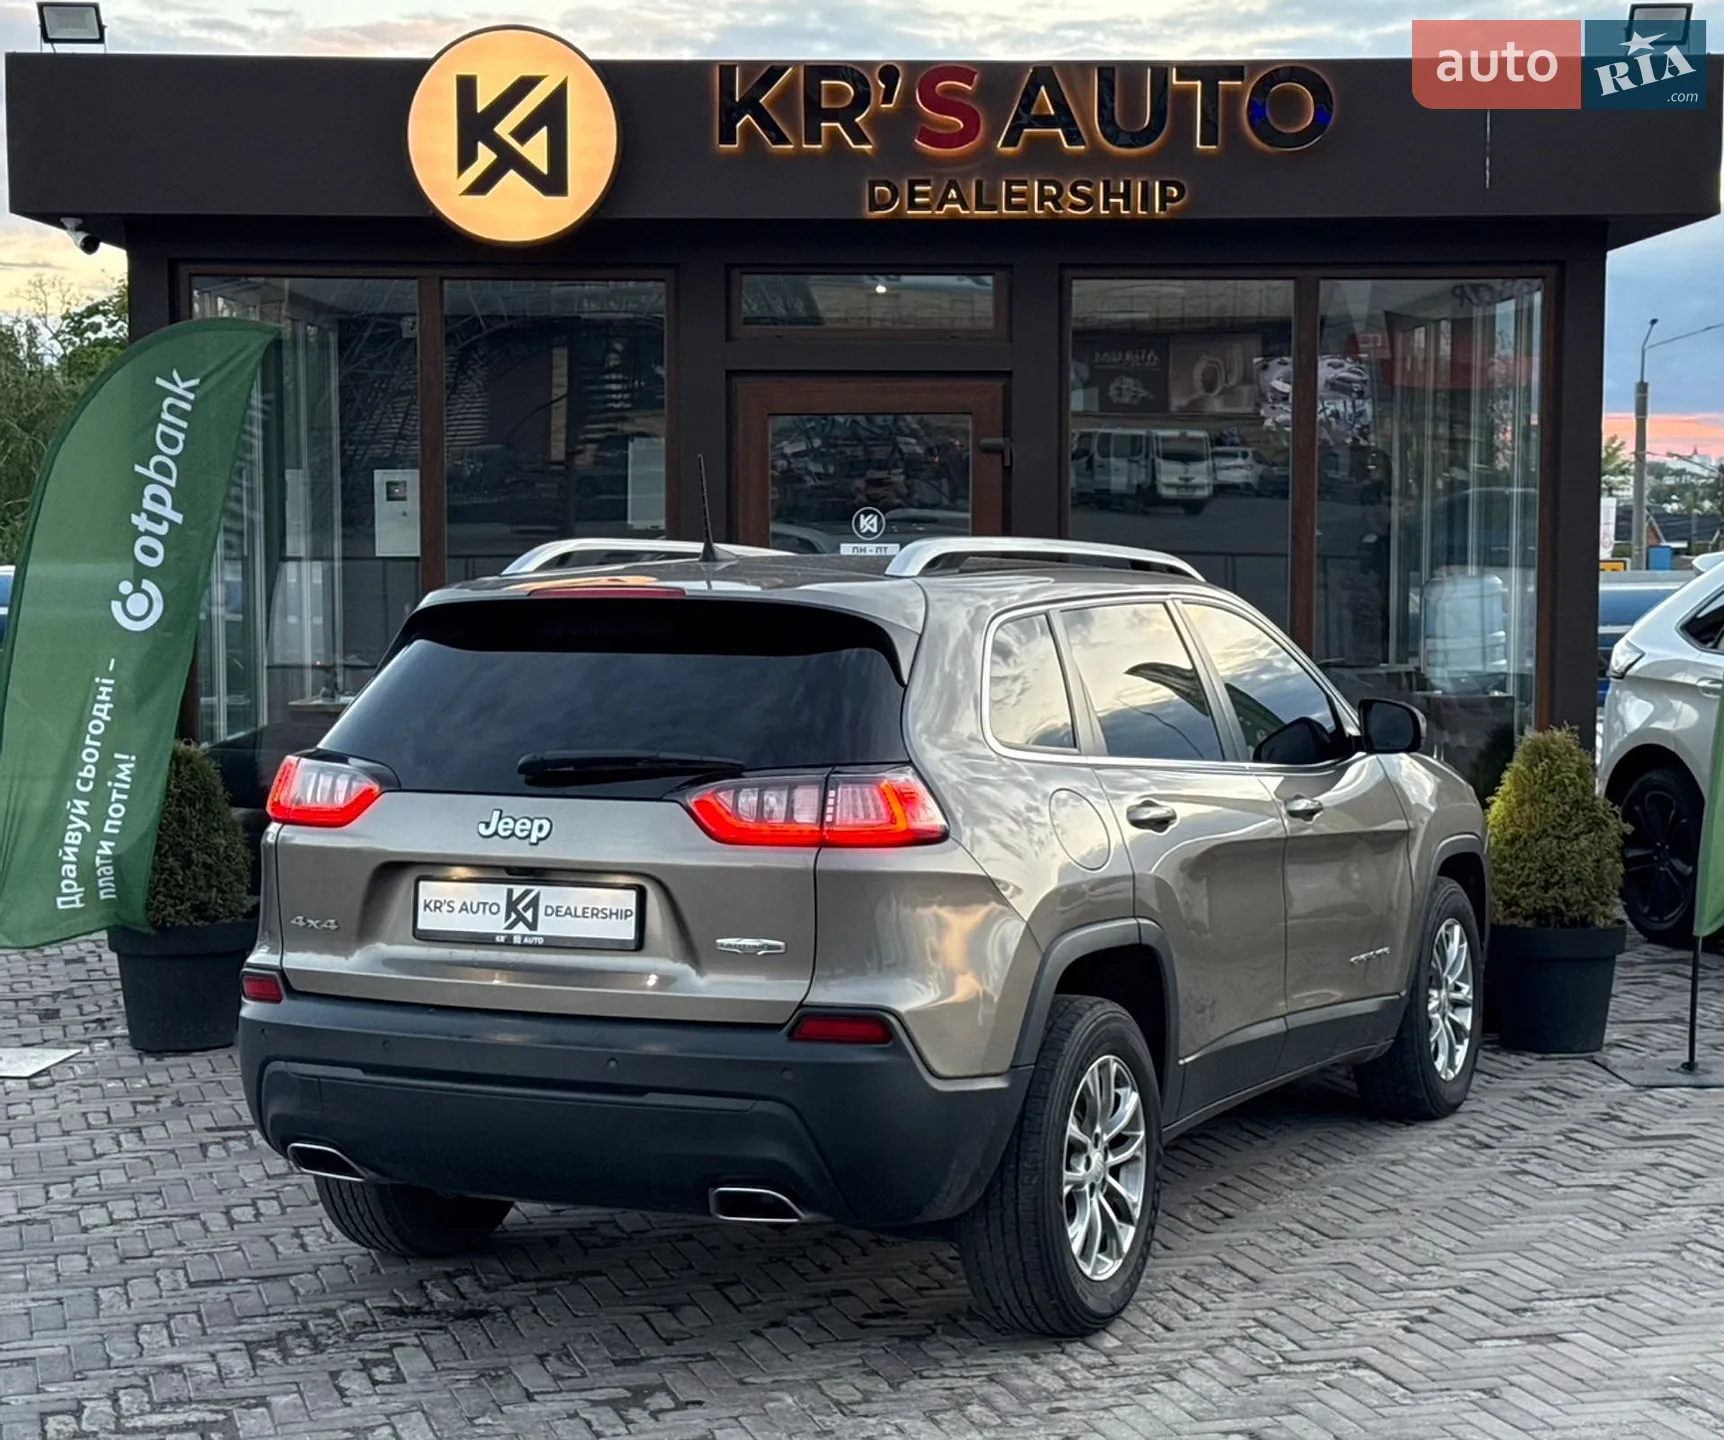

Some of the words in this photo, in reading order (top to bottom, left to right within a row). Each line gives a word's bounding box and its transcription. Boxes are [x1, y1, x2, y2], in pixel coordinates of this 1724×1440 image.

[716, 64, 983, 151] KR'S
[997, 64, 1335, 151] AUTO
[866, 178, 1187, 216] DEALERSHIP
[131, 368, 200, 568] otpbank
[56, 799, 92, 910] Драйвуй
[76, 677, 116, 793] сьогодні
[103, 752, 137, 834] потім!
[478, 808, 553, 846] Jeep
[95, 840, 117, 900] плати
[290, 915, 340, 931] 4x4
[423, 899, 455, 913] KR'S
[458, 901, 500, 916] AUTO
[544, 905, 634, 921] DEALERSHIP
[523, 936, 545, 945] AUTO
